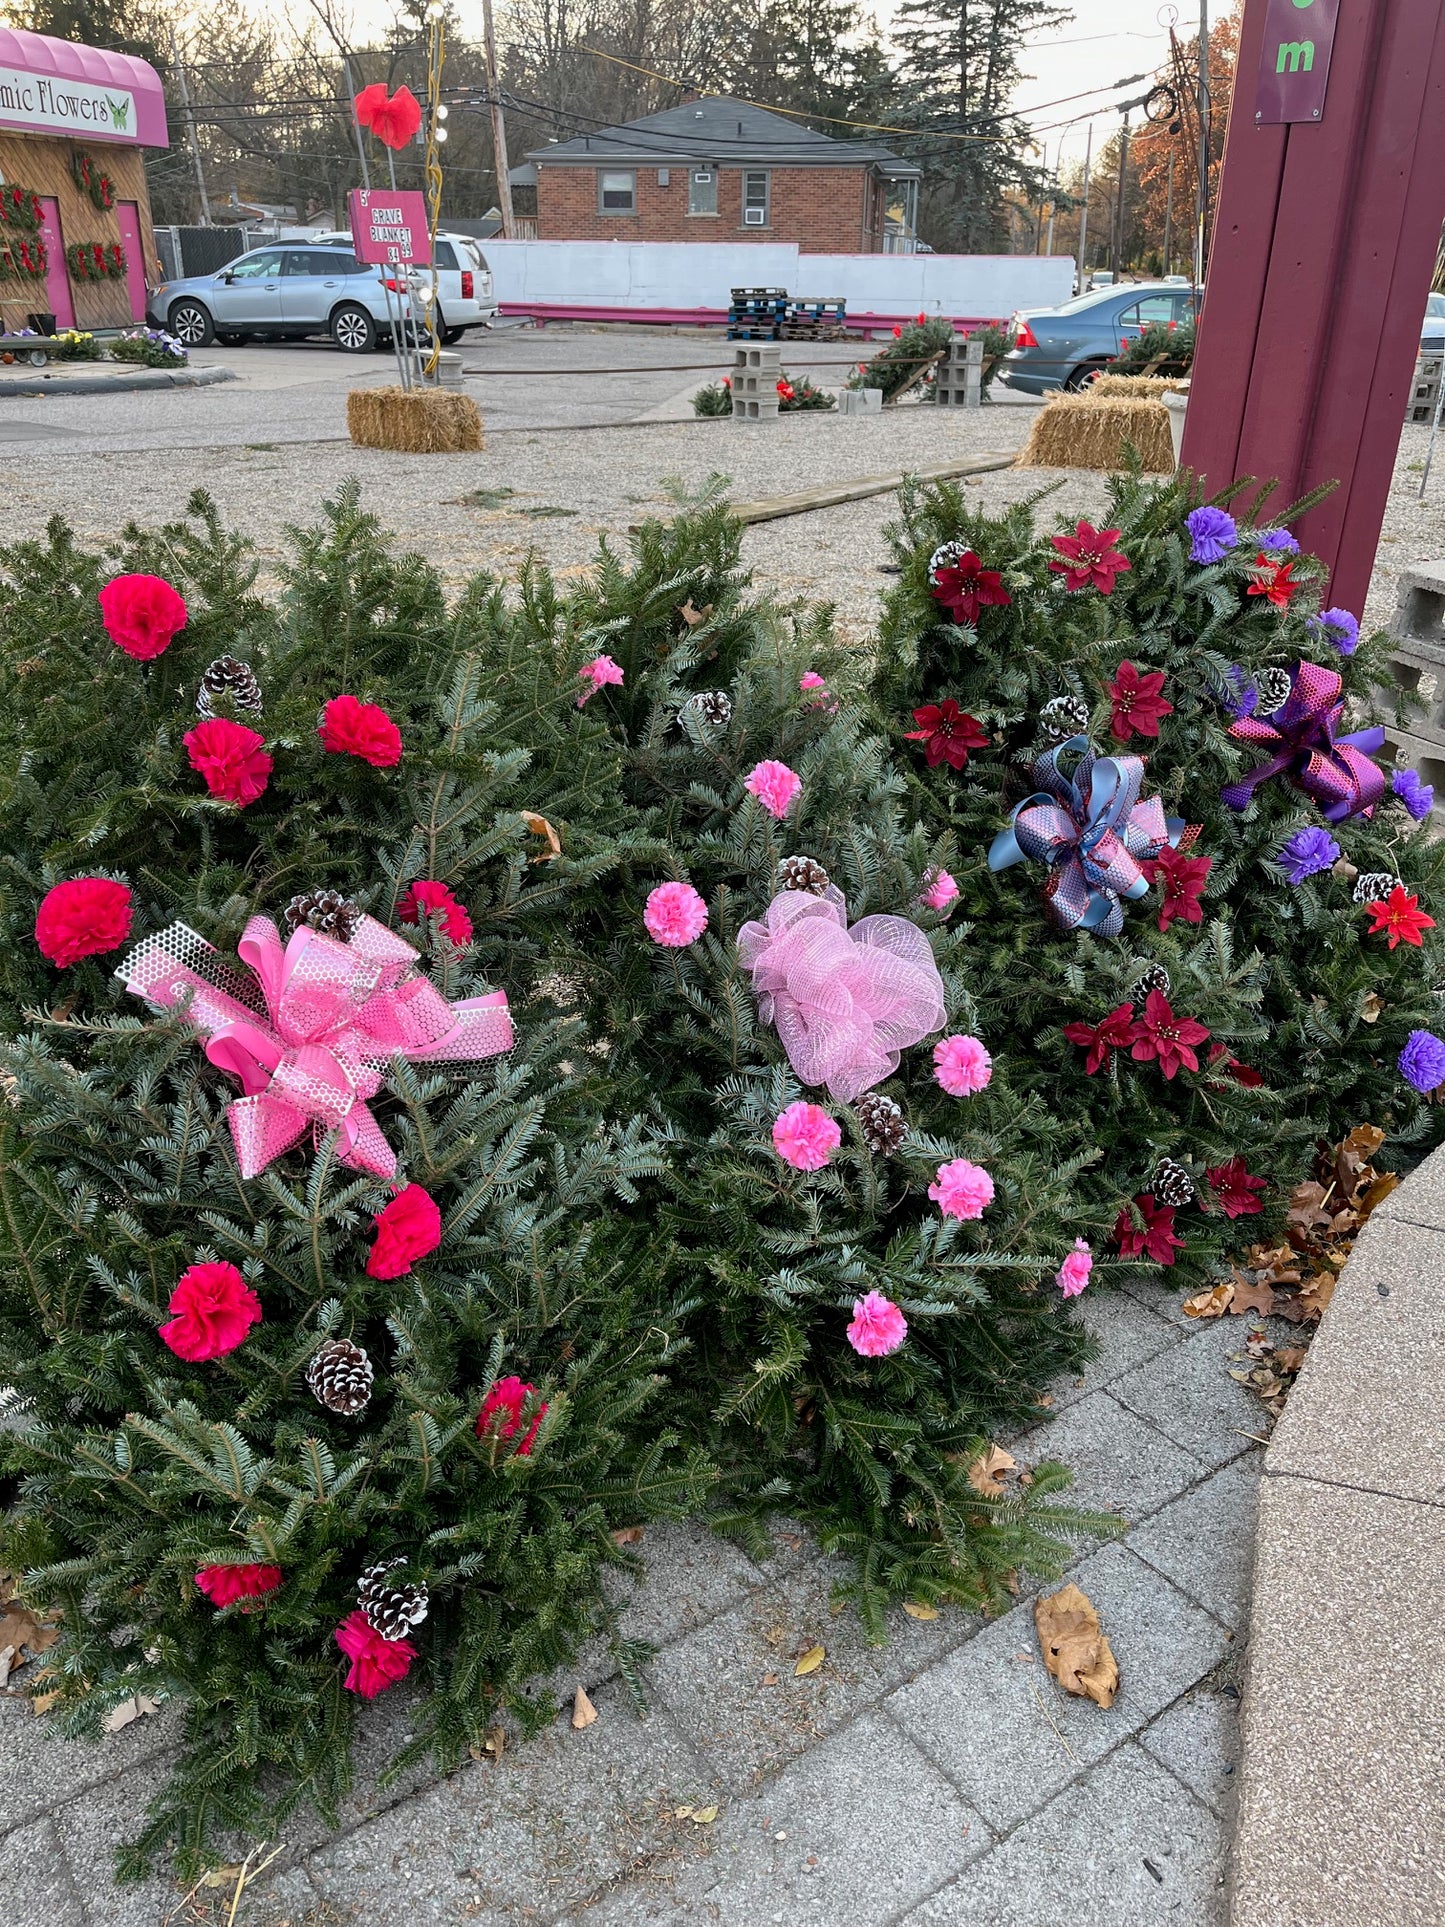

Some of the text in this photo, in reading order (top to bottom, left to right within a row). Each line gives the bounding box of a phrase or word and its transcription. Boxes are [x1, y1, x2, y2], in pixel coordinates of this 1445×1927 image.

[36, 80, 109, 122] Flowers
[373, 209, 401, 223] GRAVE
[370, 226, 410, 242] BLANKET
